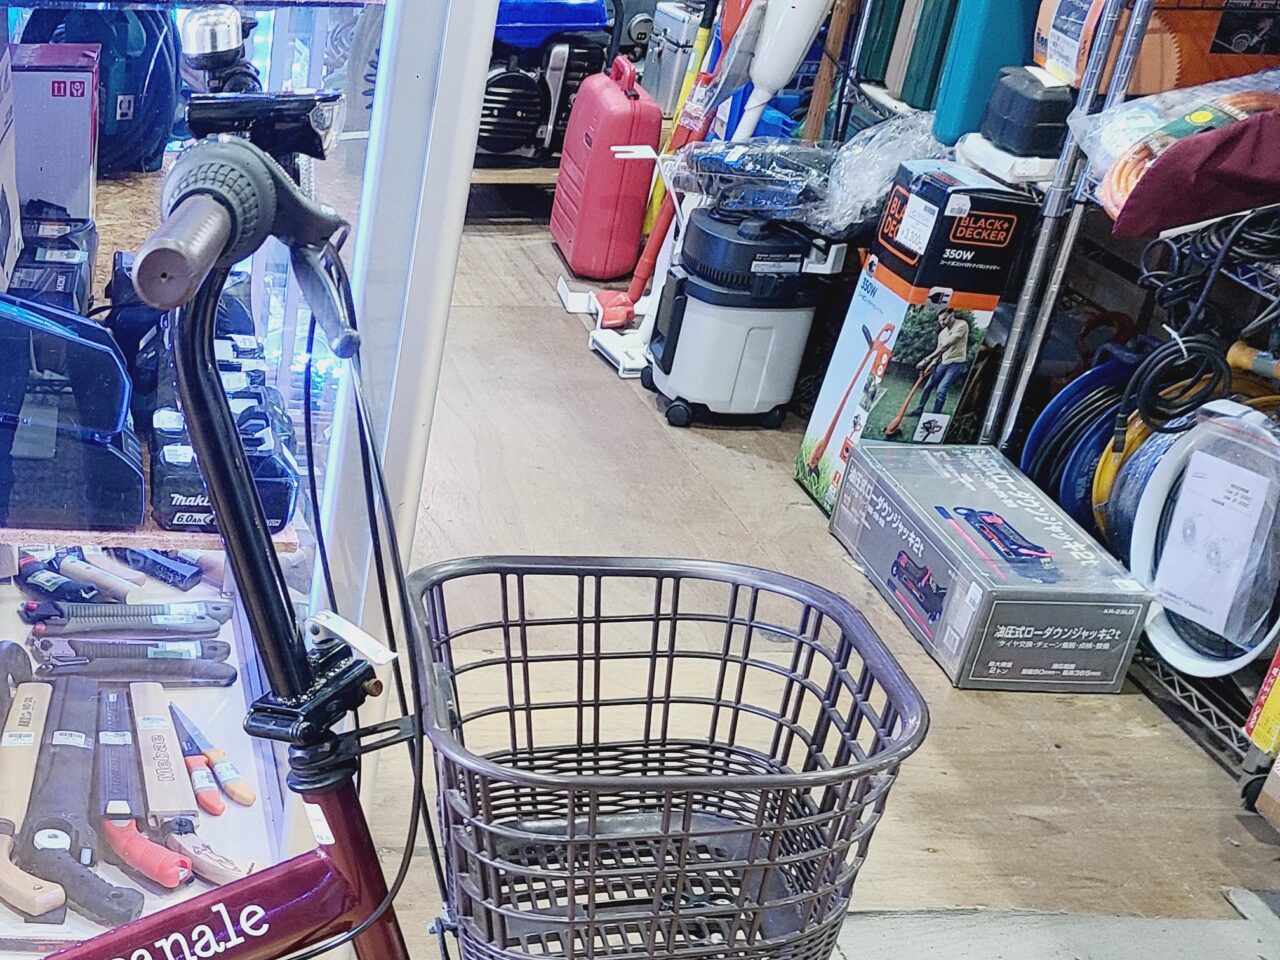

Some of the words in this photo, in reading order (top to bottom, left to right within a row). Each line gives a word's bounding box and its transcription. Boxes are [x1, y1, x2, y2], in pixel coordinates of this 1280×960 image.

[956, 226, 1007, 242] DECKER
[943, 248, 976, 261] 350W
[993, 624, 1122, 641] 油圧式ローダウンジャッキ2t
